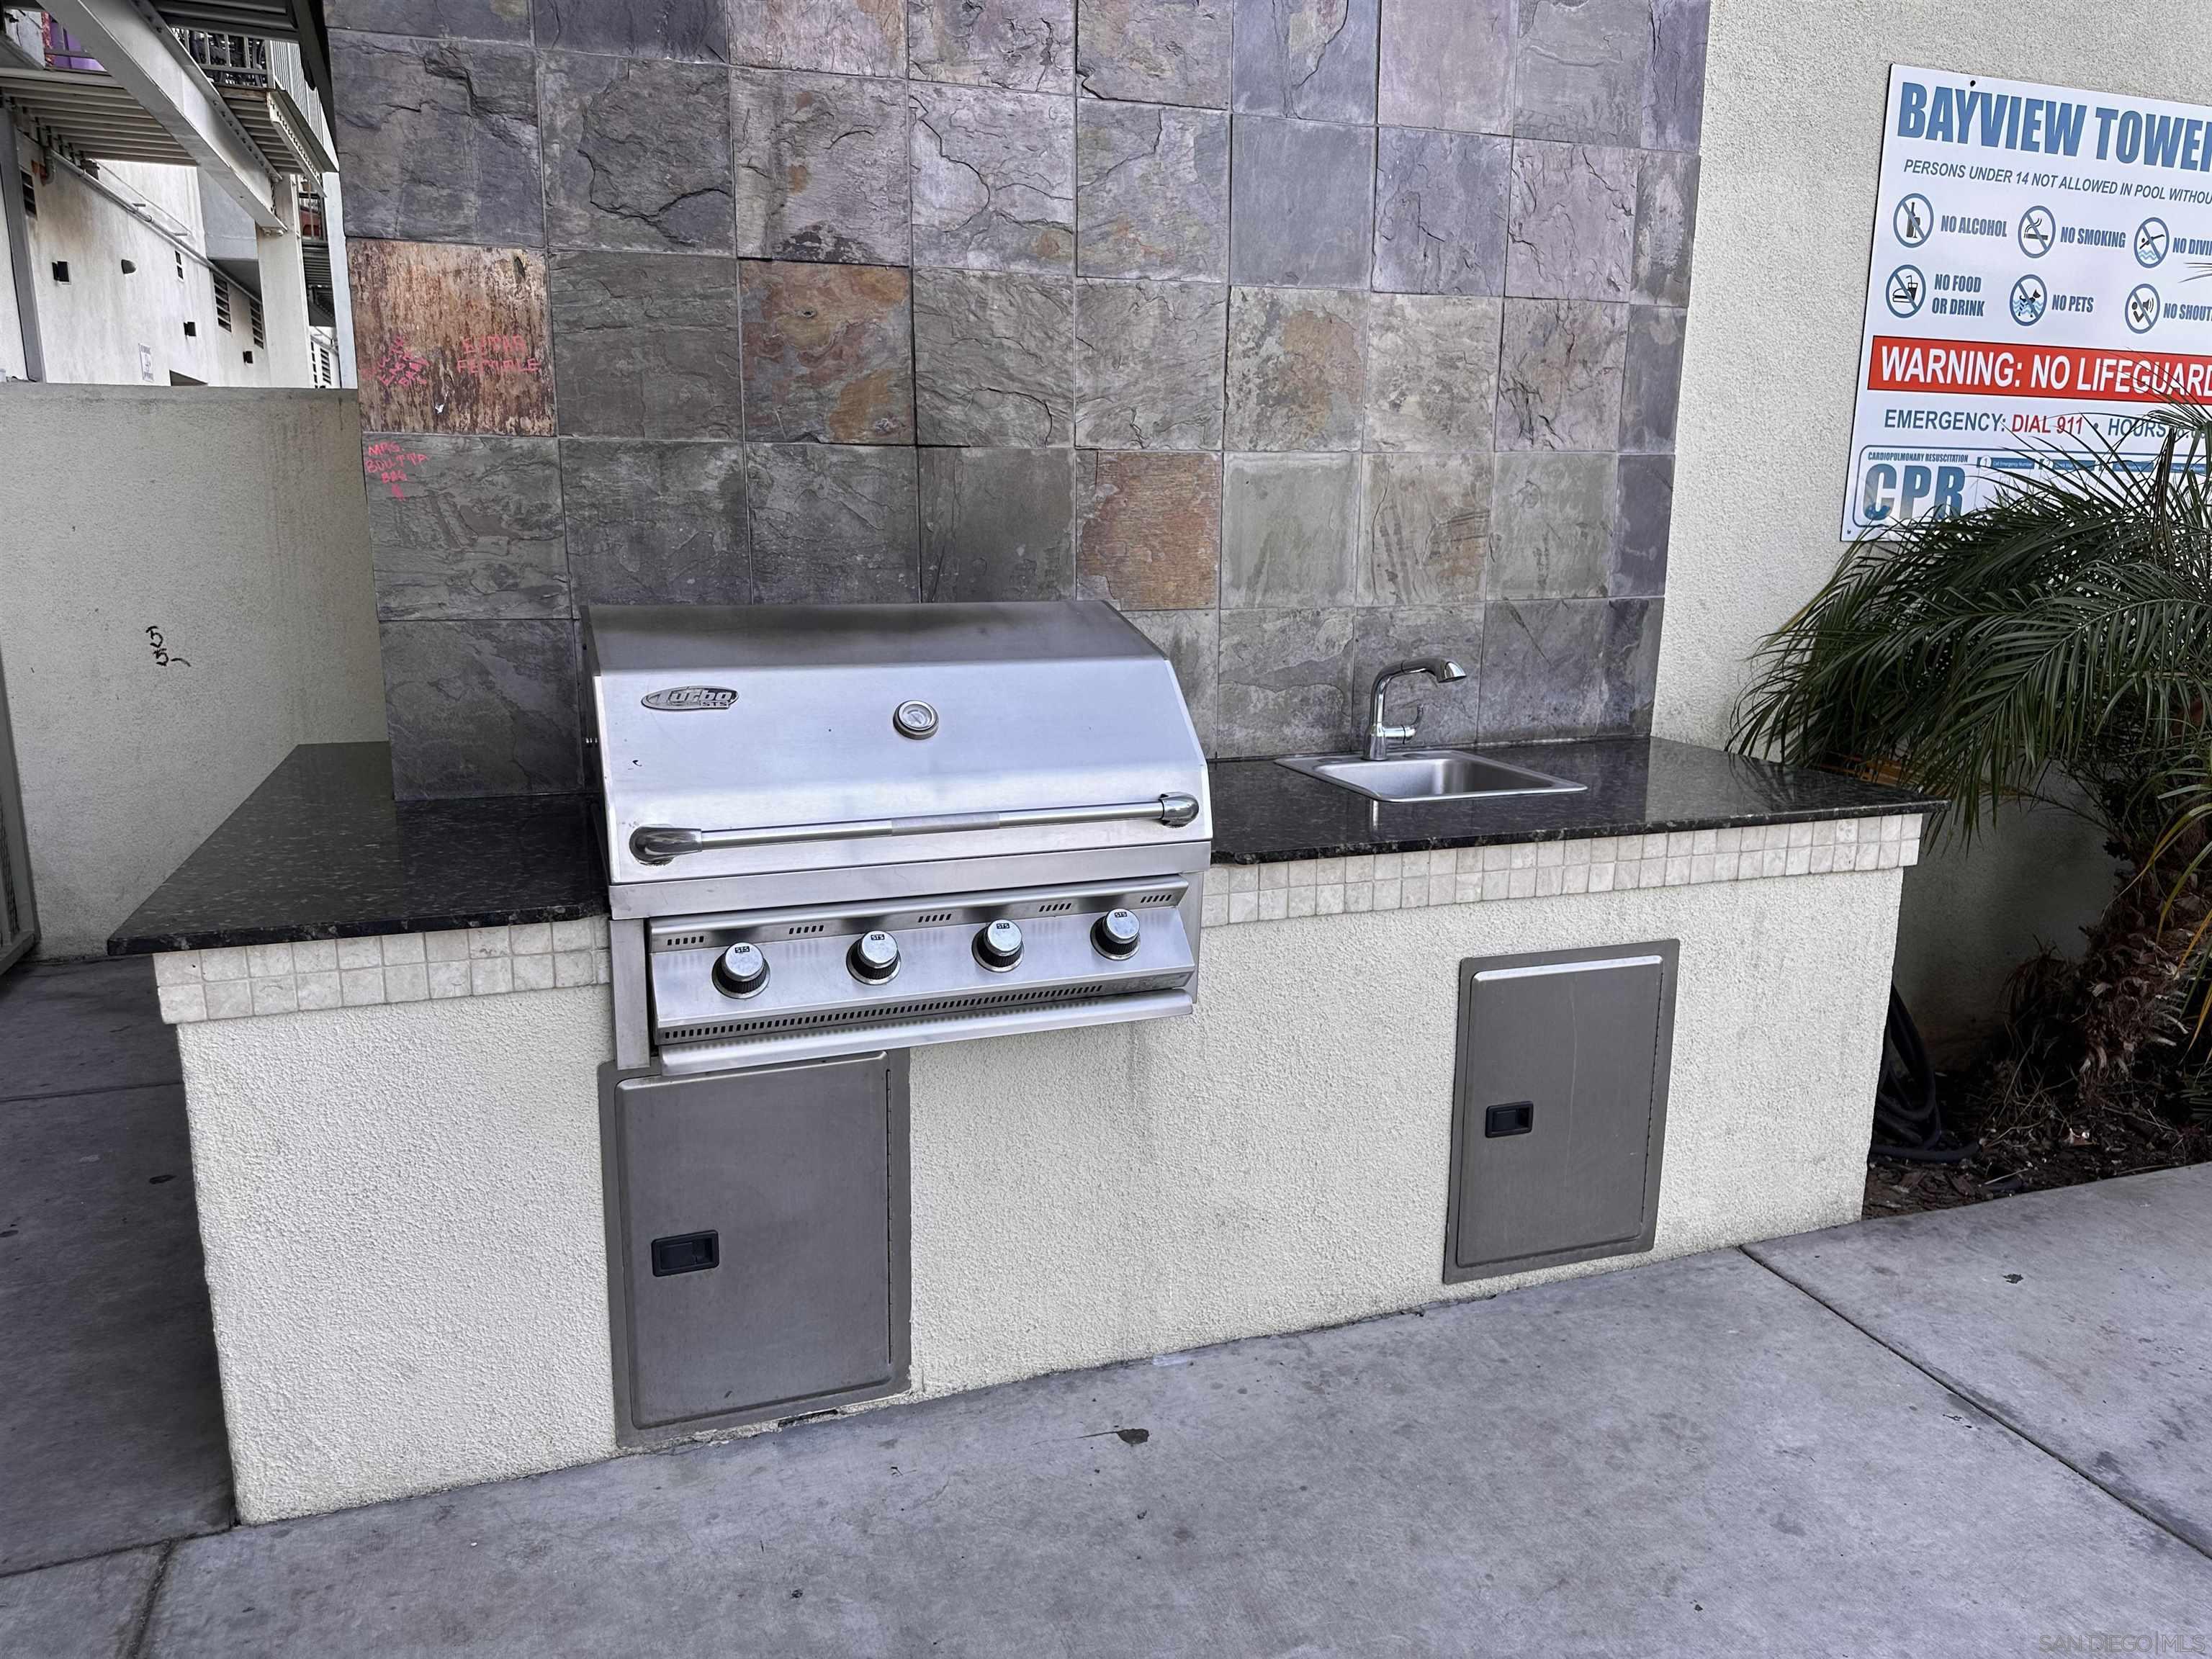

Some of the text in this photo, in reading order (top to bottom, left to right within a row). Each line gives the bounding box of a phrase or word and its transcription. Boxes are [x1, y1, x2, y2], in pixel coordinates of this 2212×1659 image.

[1897, 82, 2087, 157] BAYVIEW
[1904, 159, 1966, 178] PERSONS
[1969, 166, 2013, 183] UNDER
[2015, 171, 2029, 185] 14
[2031, 173, 2058, 188] NOT
[2059, 176, 2118, 194] ALLOWED
[2120, 183, 2133, 196] IN
[2134, 184, 2165, 200] POOL
[1941, 215, 2008, 238] NO ALCOHOL
[2060, 227, 2126, 248] NO SMOKING
[2172, 238, 2187, 253] NO
[1934, 274, 1982, 293] NO FOOD
[1932, 297, 1985, 317] OR DRINK
[2051, 295, 2095, 313] NO PETS
[2163, 303, 2212, 322] NO SHOUT
[1881, 346, 2022, 388] WARNING:
[2031, 354, 2070, 390] NO
[1884, 409, 2006, 432] EMERGENCY:
[2012, 414, 2051, 433] DIAL
[2056, 415, 2083, 435] 911
[1868, 451, 1969, 463] CARDIOPULMONARY RESUSCITATION
[1863, 463, 1966, 521] CPR
